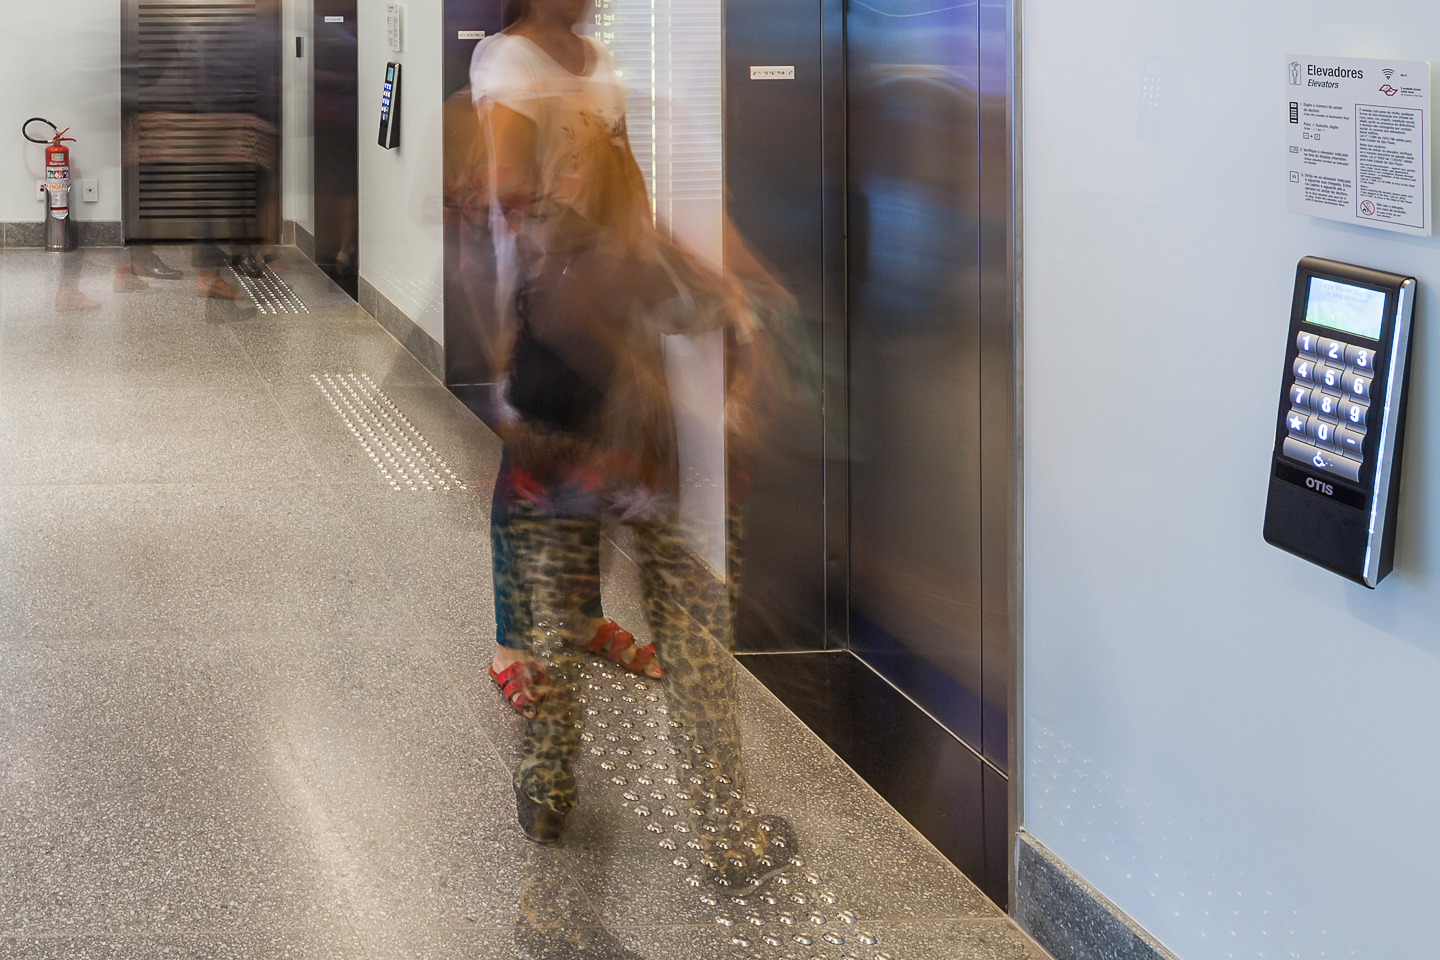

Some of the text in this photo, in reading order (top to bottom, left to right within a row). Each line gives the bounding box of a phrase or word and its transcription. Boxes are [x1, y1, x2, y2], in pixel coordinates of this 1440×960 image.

[594, 13, 601, 25] 12
[1307, 64, 1364, 79] Elevadores
[1307, 79, 1339, 89] Elevators
[1302, 335, 1368, 367] 1 2 3
[1297, 362, 1364, 395] 4 5 6
[1295, 387, 1361, 423] 7 8 9
[1317, 423, 1328, 441] 0
[1305, 477, 1334, 496] OTIS
